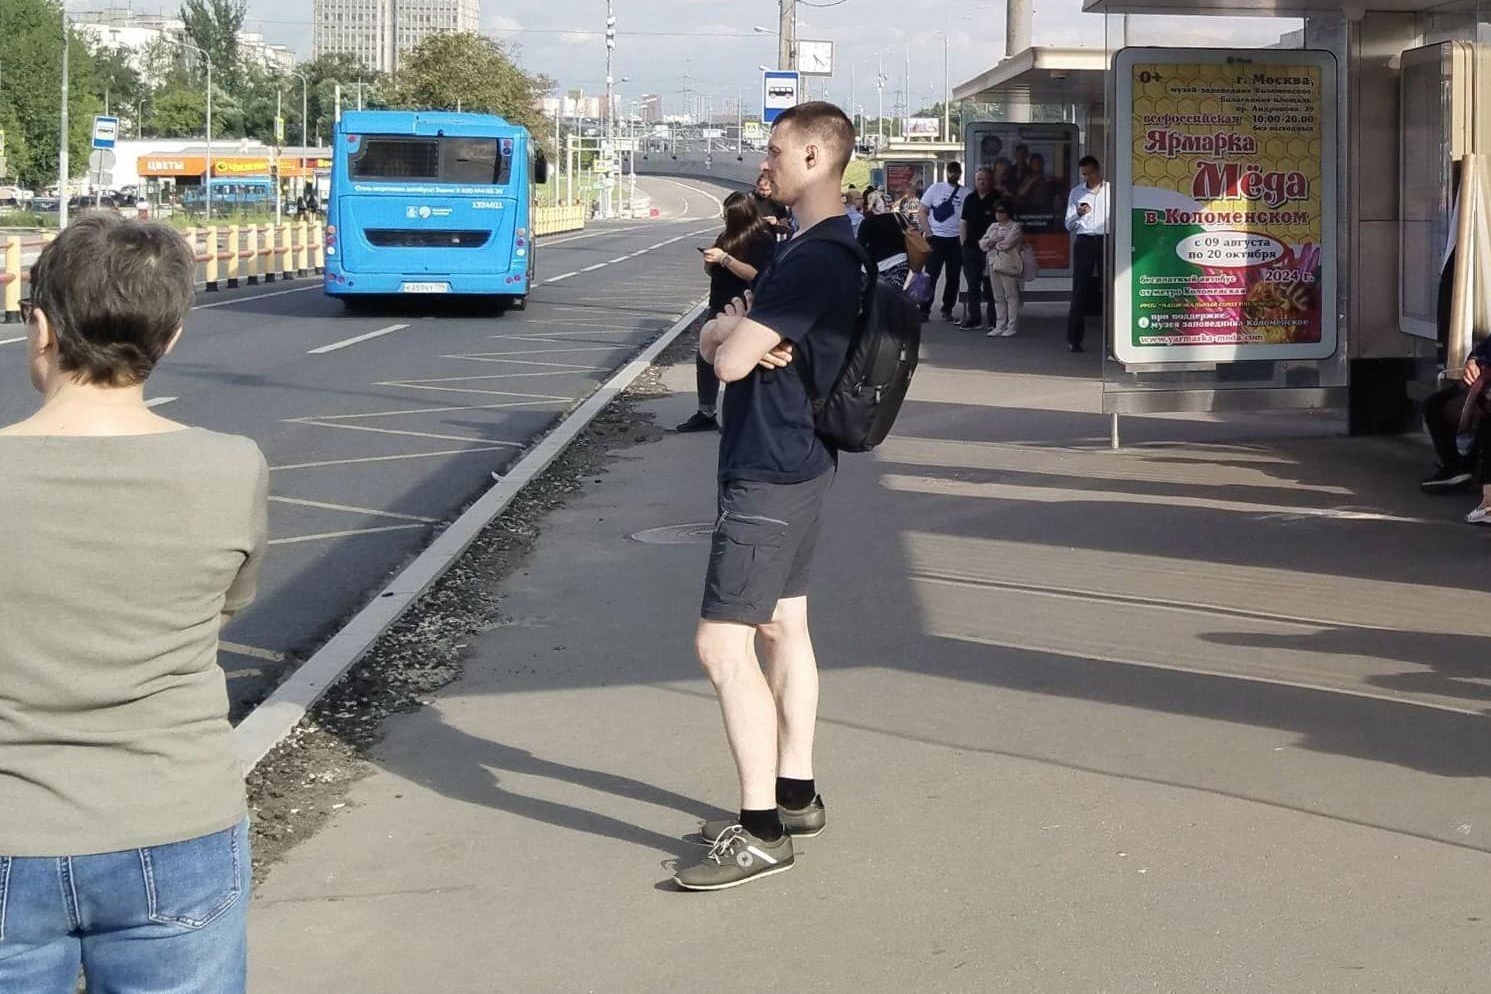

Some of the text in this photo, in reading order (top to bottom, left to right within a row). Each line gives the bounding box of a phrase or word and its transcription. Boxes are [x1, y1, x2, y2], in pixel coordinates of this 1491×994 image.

[1139, 72, 1163, 84] 0+
[1252, 74, 1315, 87] Москва,
[1143, 114, 1241, 127] всероссийская
[1145, 130, 1257, 157] Ярмарка
[1193, 162, 1308, 207] Мёда
[1145, 209, 1309, 225] в Коломенском
[1194, 237, 1271, 250] с 09 августа
[1188, 249, 1277, 261] по 20 октября
[1264, 270, 1315, 282] 2024 г.
